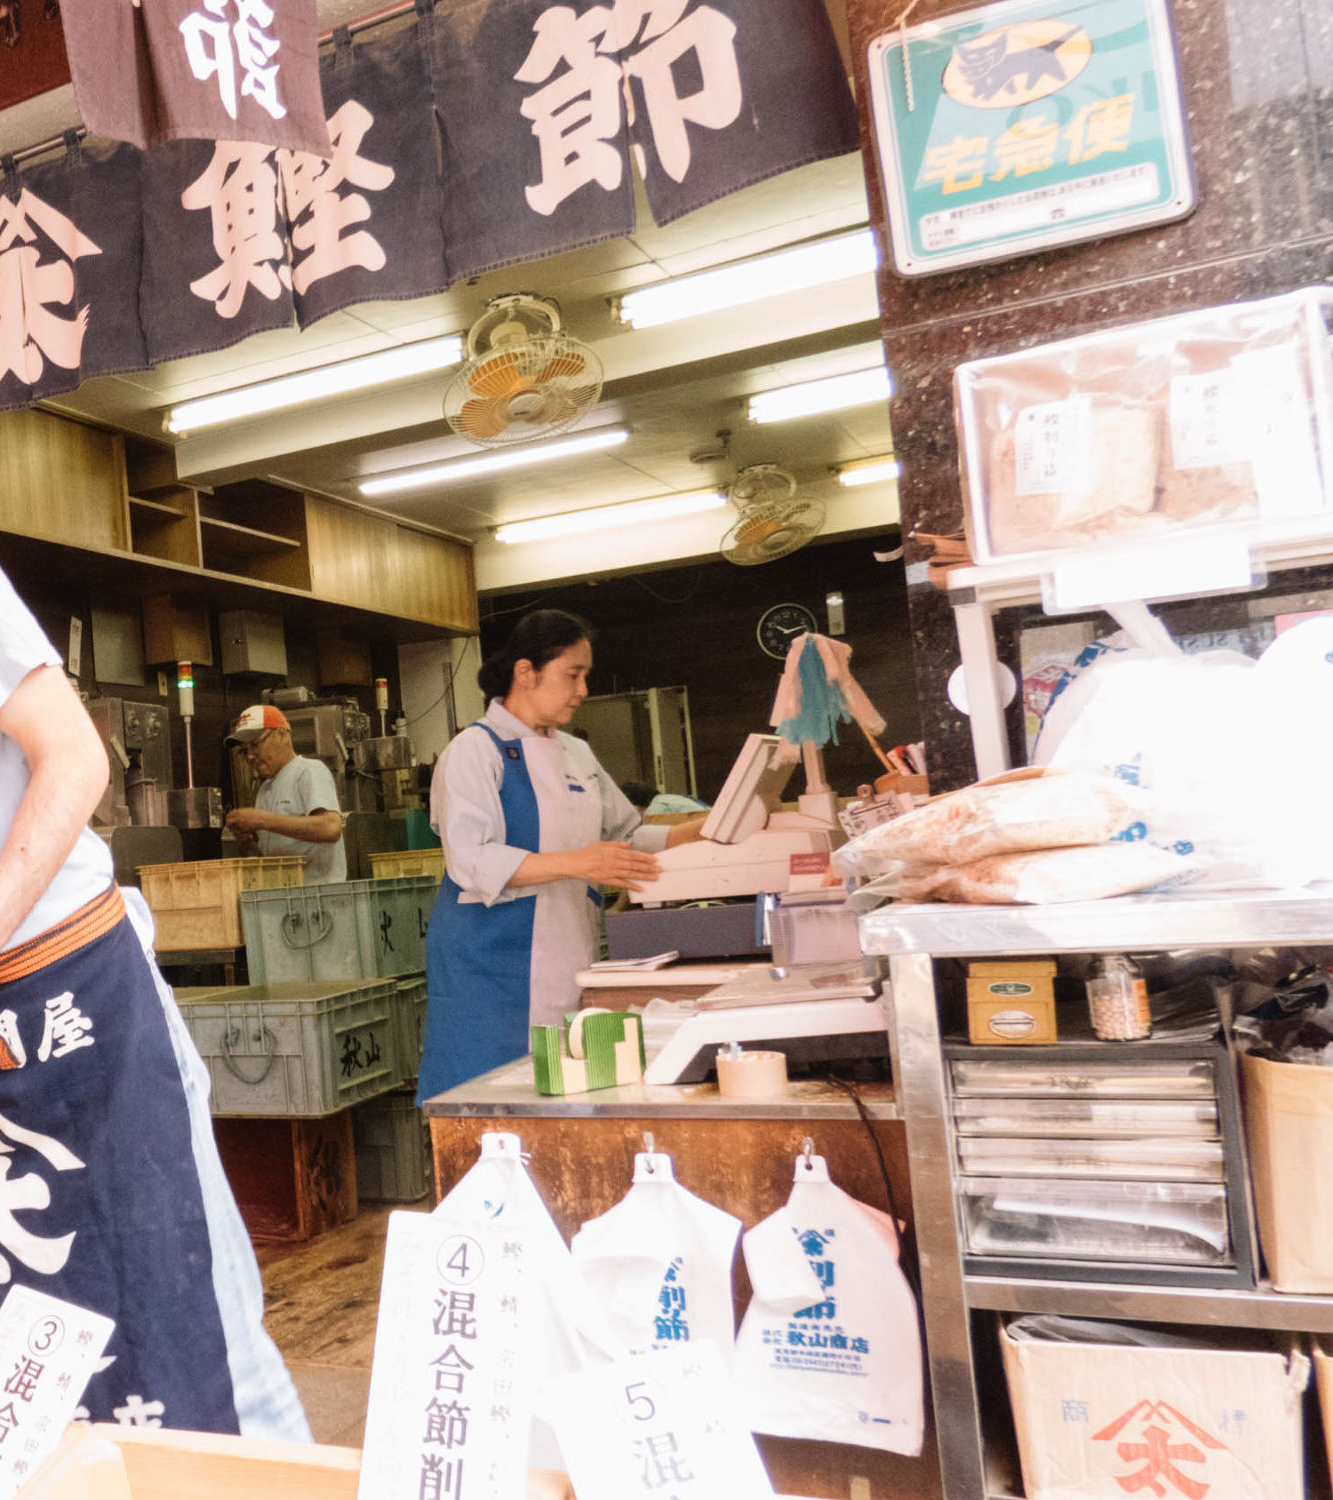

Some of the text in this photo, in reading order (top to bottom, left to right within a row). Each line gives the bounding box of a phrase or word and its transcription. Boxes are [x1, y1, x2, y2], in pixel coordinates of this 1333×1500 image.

[921, 93, 1137, 196] 宅急便
[340, 1031, 382, 1078] 秋山
[787, 1331, 869, 1354] 秋山商店
